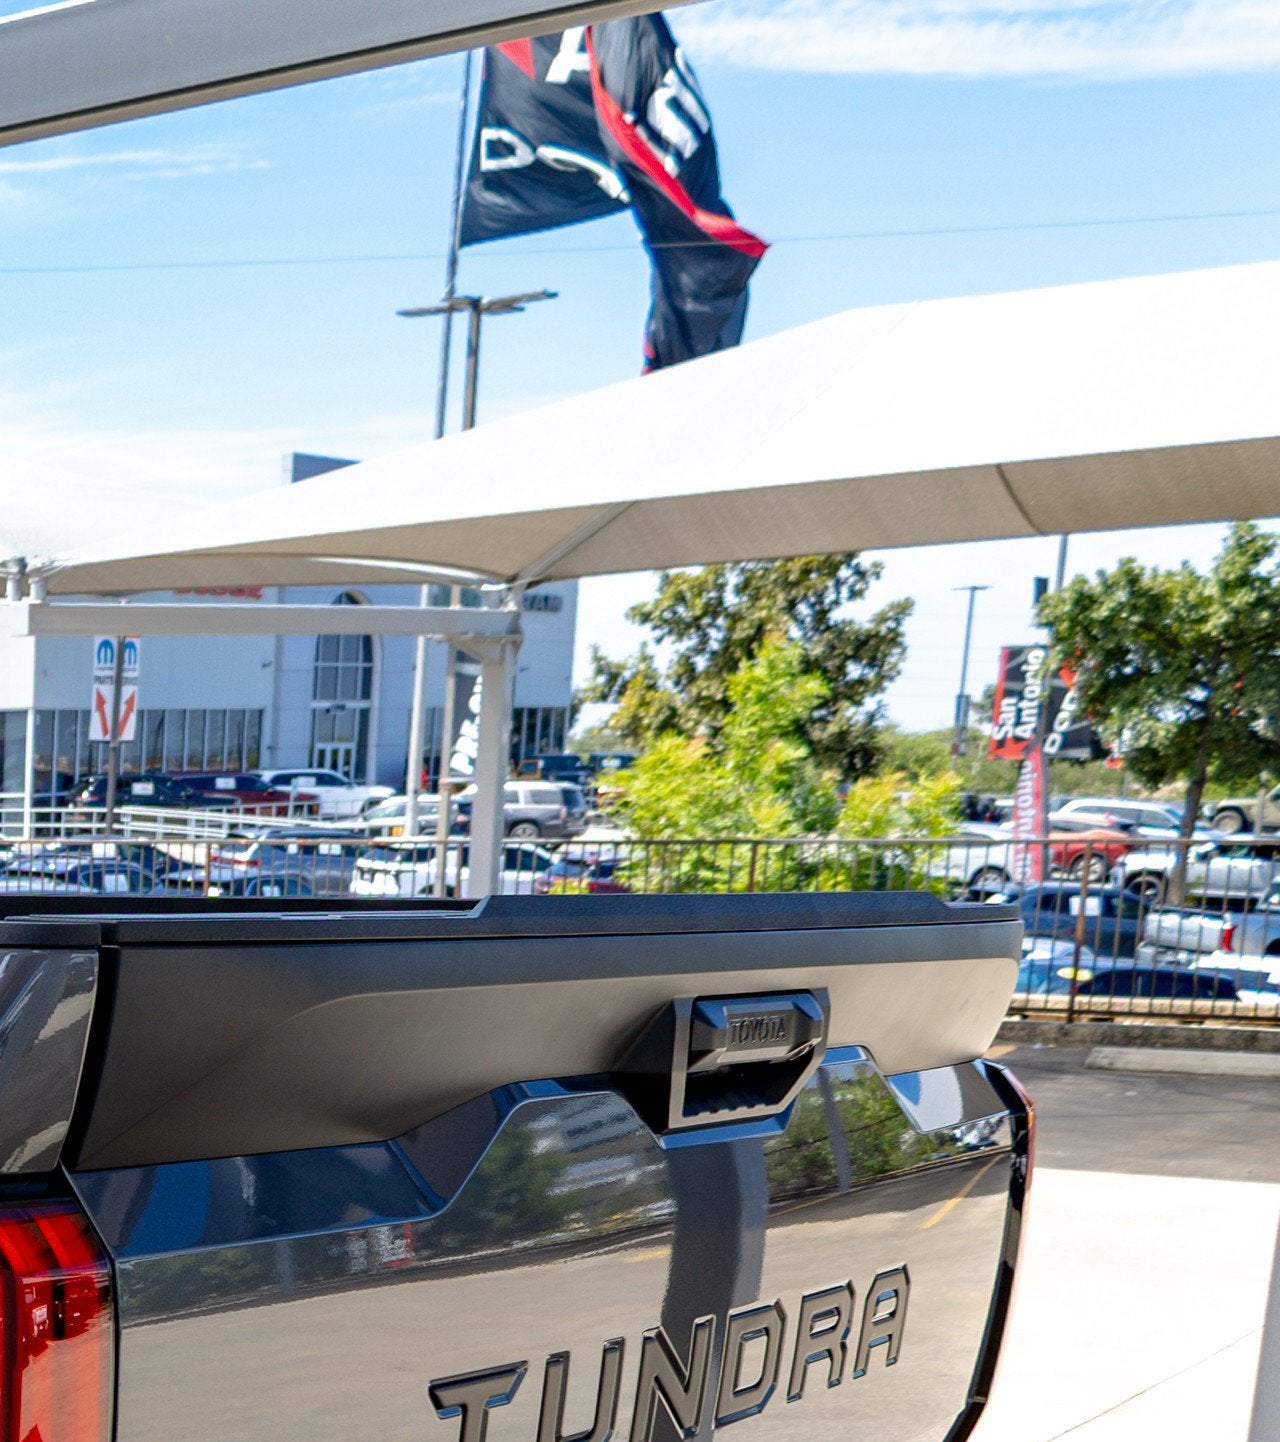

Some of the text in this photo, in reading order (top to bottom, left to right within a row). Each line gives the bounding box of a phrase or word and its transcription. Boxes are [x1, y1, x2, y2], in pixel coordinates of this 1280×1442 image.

[1014, 648, 1045, 739] Antonio
[992, 696, 1018, 741] San
[730, 1014, 787, 1046] TOYOTA
